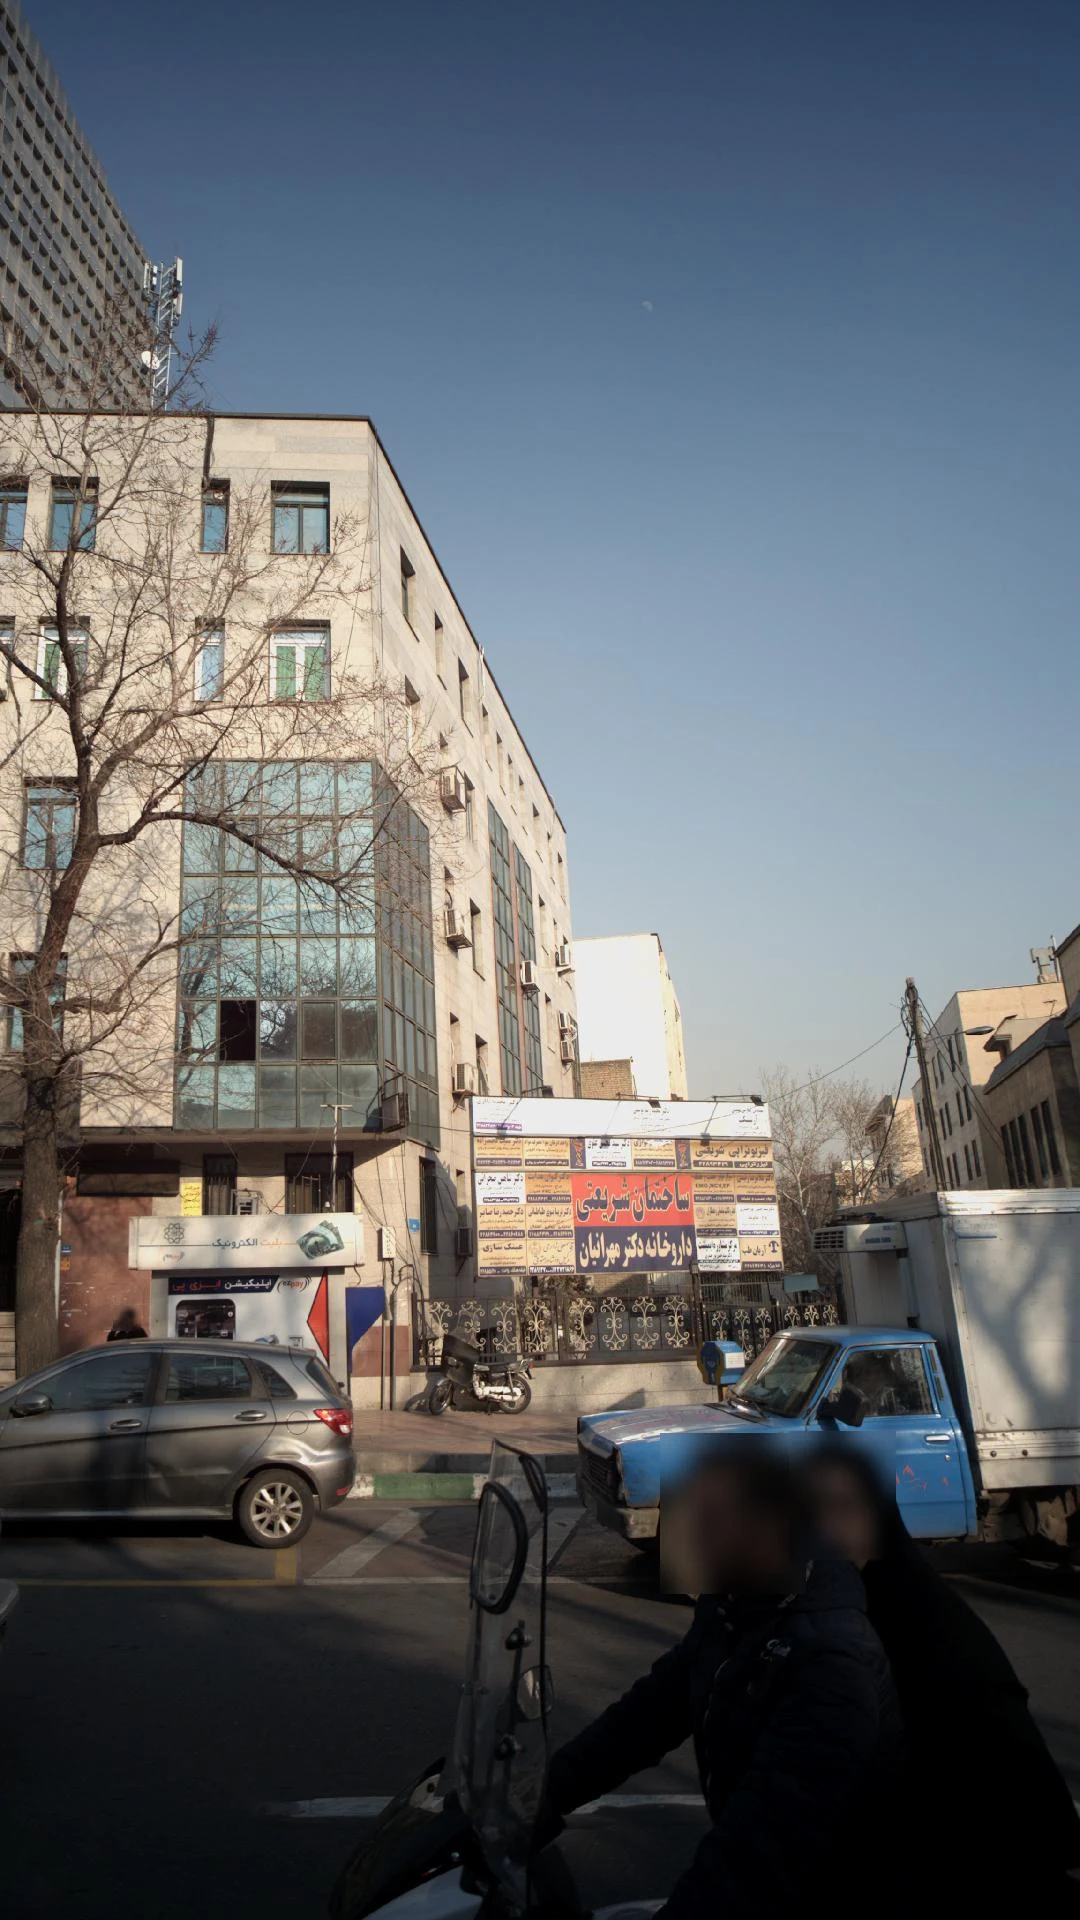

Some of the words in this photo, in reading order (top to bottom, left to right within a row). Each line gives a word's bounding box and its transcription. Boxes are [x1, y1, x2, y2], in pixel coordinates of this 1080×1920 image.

[576, 1177, 630, 1223] شریعتی
[632, 1176, 690, 1223] ساختمان
[211, 1238, 258, 1249] الکترونیک
[579, 1231, 621, 1268] مهرانیان
[622, 1231, 644, 1267] دکتر
[645, 1231, 693, 1265] داروخانه
[224, 1278, 272, 1290] اپلیکیشن
